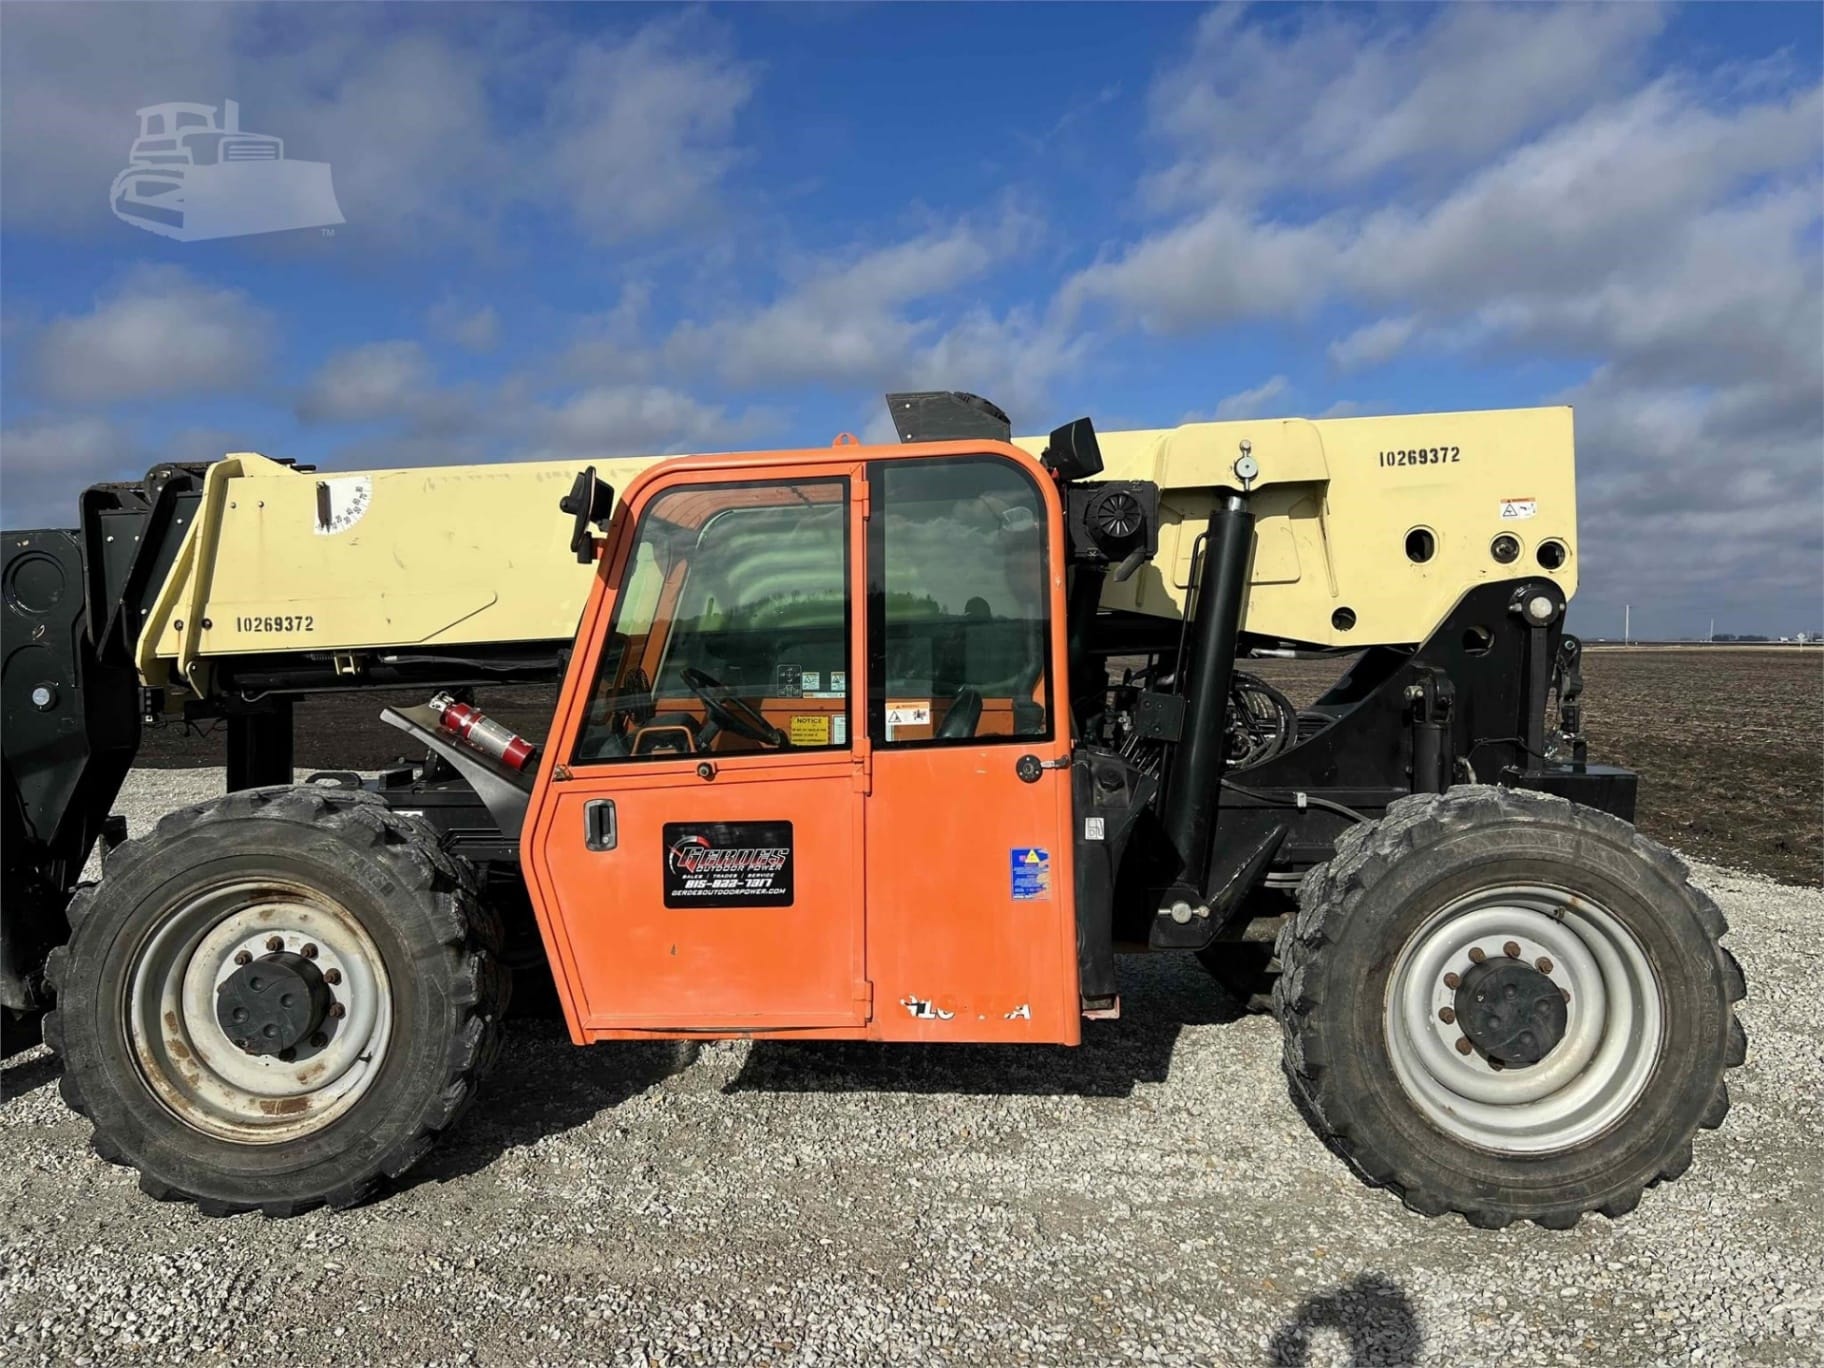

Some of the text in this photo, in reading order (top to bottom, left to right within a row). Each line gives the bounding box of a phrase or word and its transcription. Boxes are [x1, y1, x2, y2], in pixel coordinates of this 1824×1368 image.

[1380, 446, 1460, 467] 10269372
[237, 616, 314, 632] 10269372
[747, 863, 783, 871] POWER
